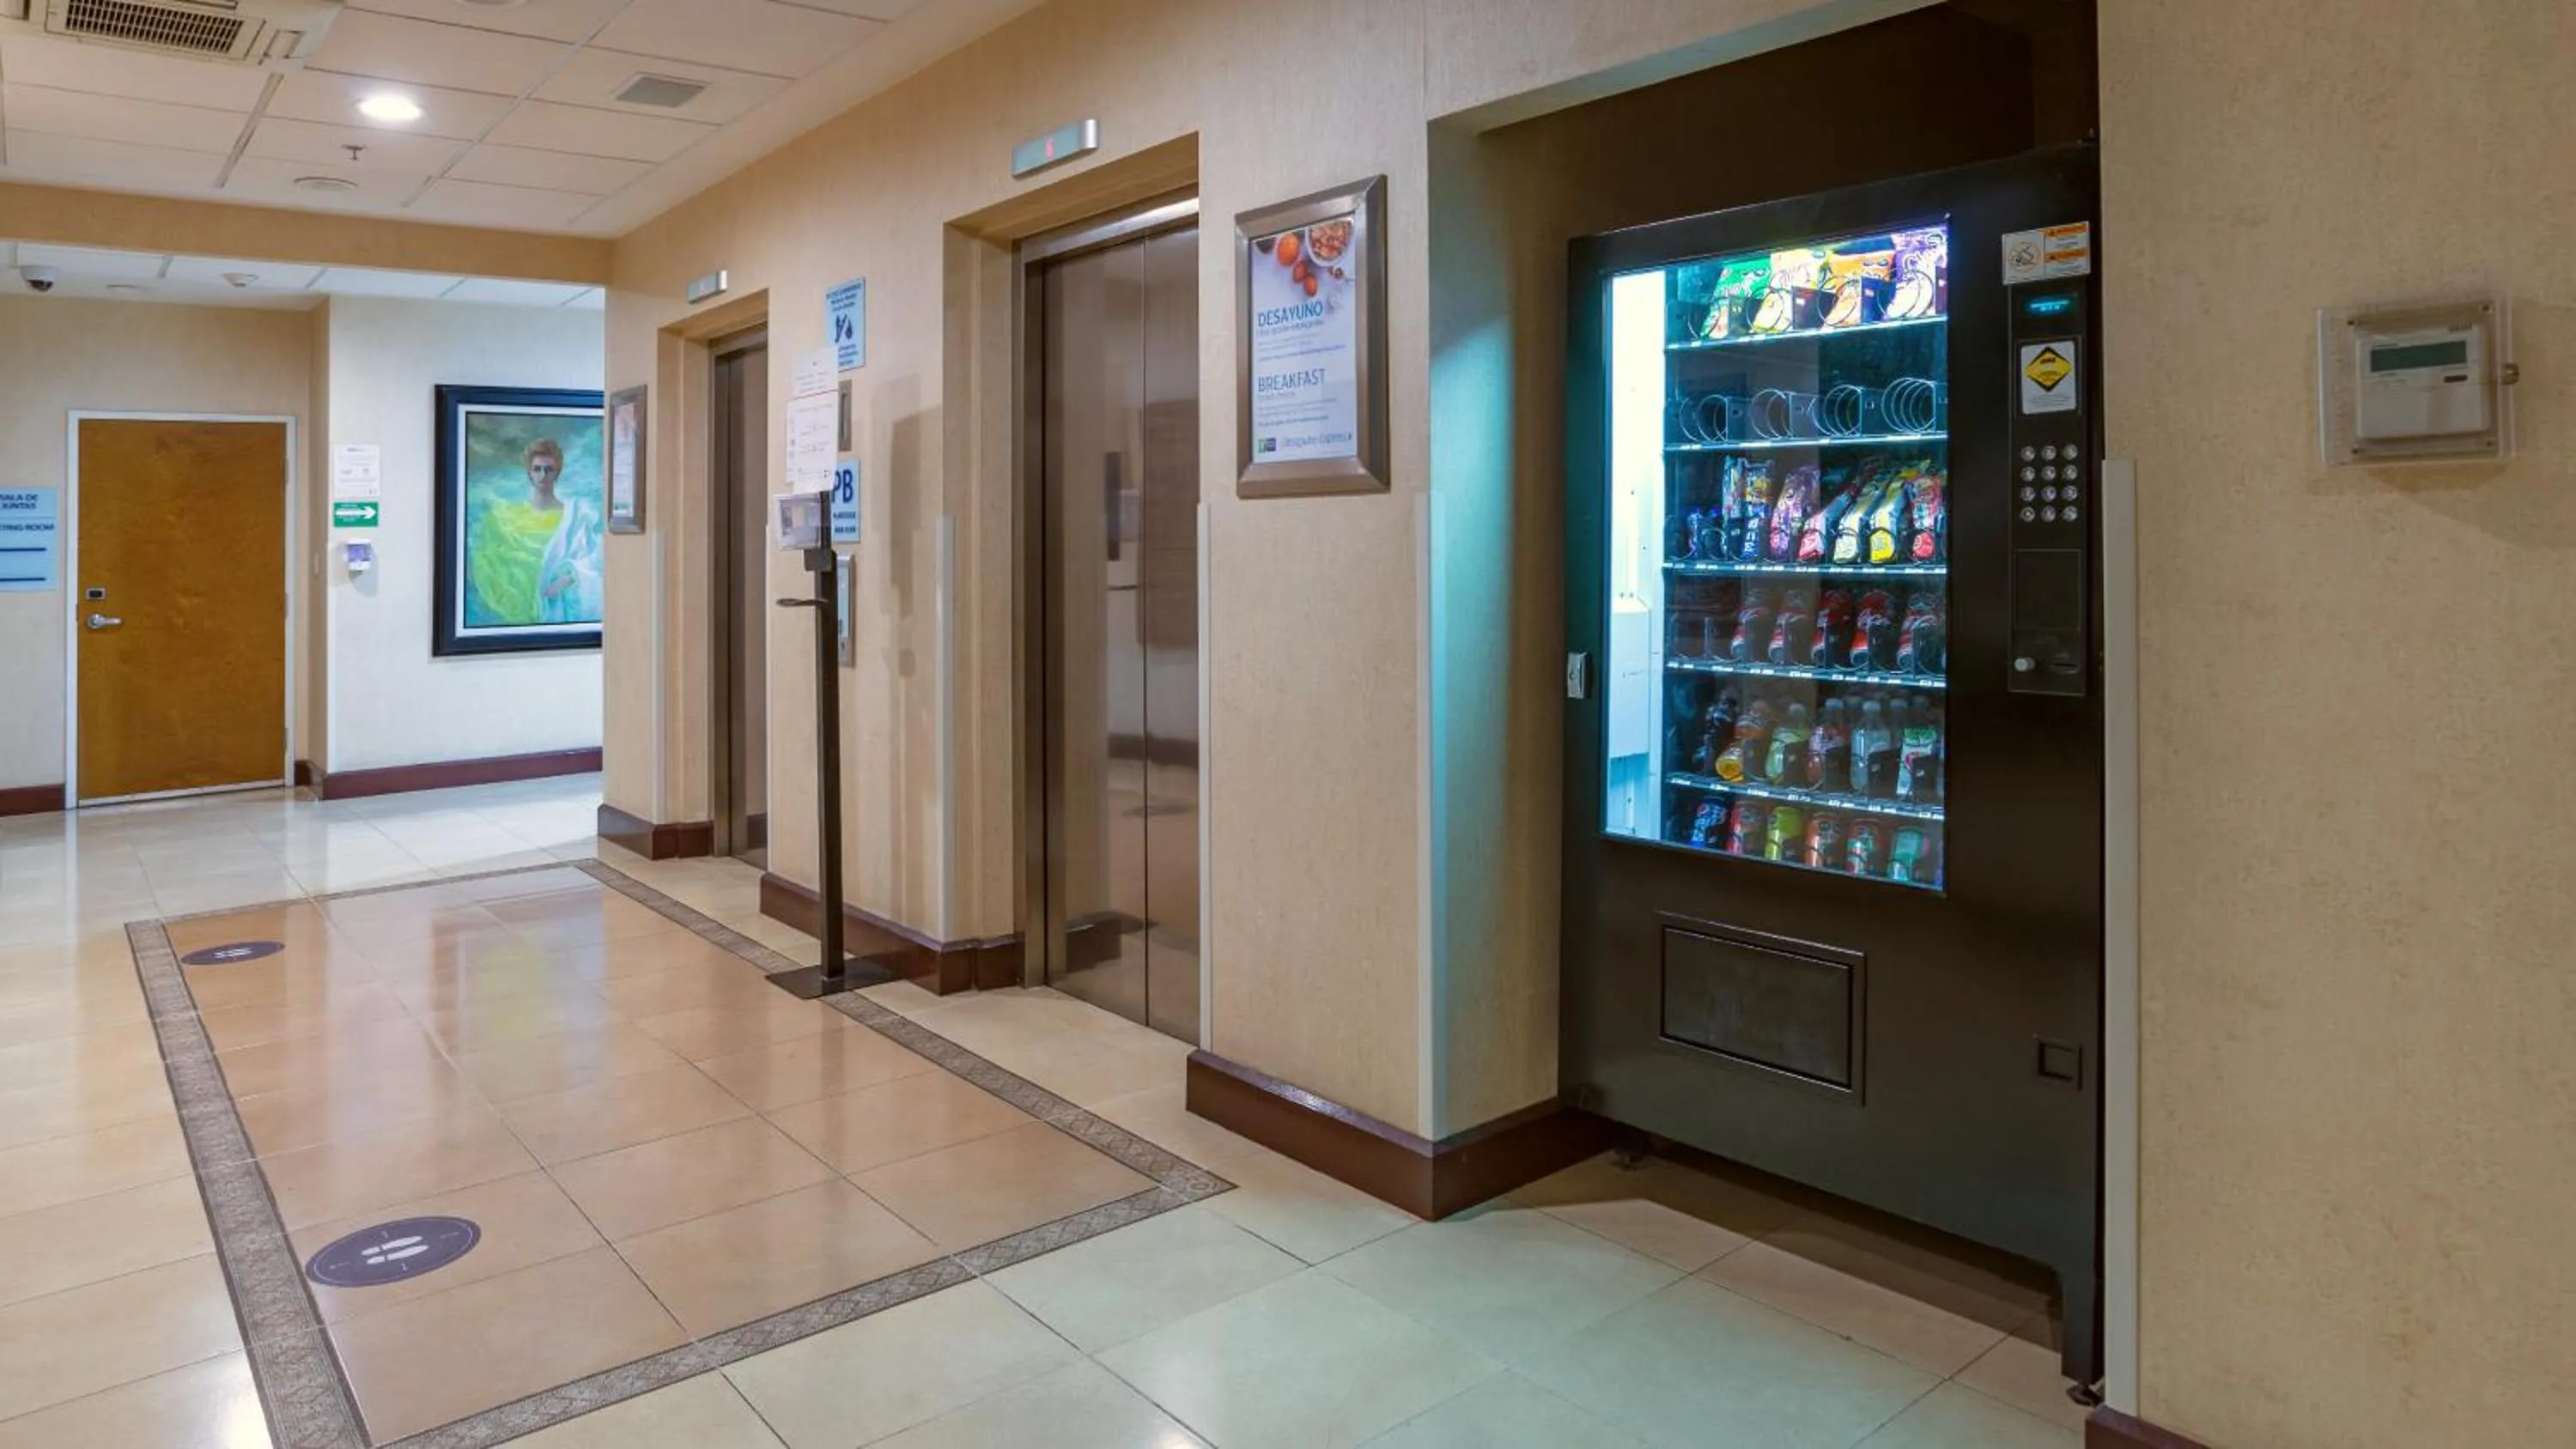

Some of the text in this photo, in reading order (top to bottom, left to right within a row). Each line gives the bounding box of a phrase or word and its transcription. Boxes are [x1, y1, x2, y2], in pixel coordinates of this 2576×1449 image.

[1257, 301, 1323, 327] DESAYUNO
[1257, 368, 1327, 392] BREAKFAST
[25, 494, 39, 502] DE
[831, 469, 854, 504] PB
